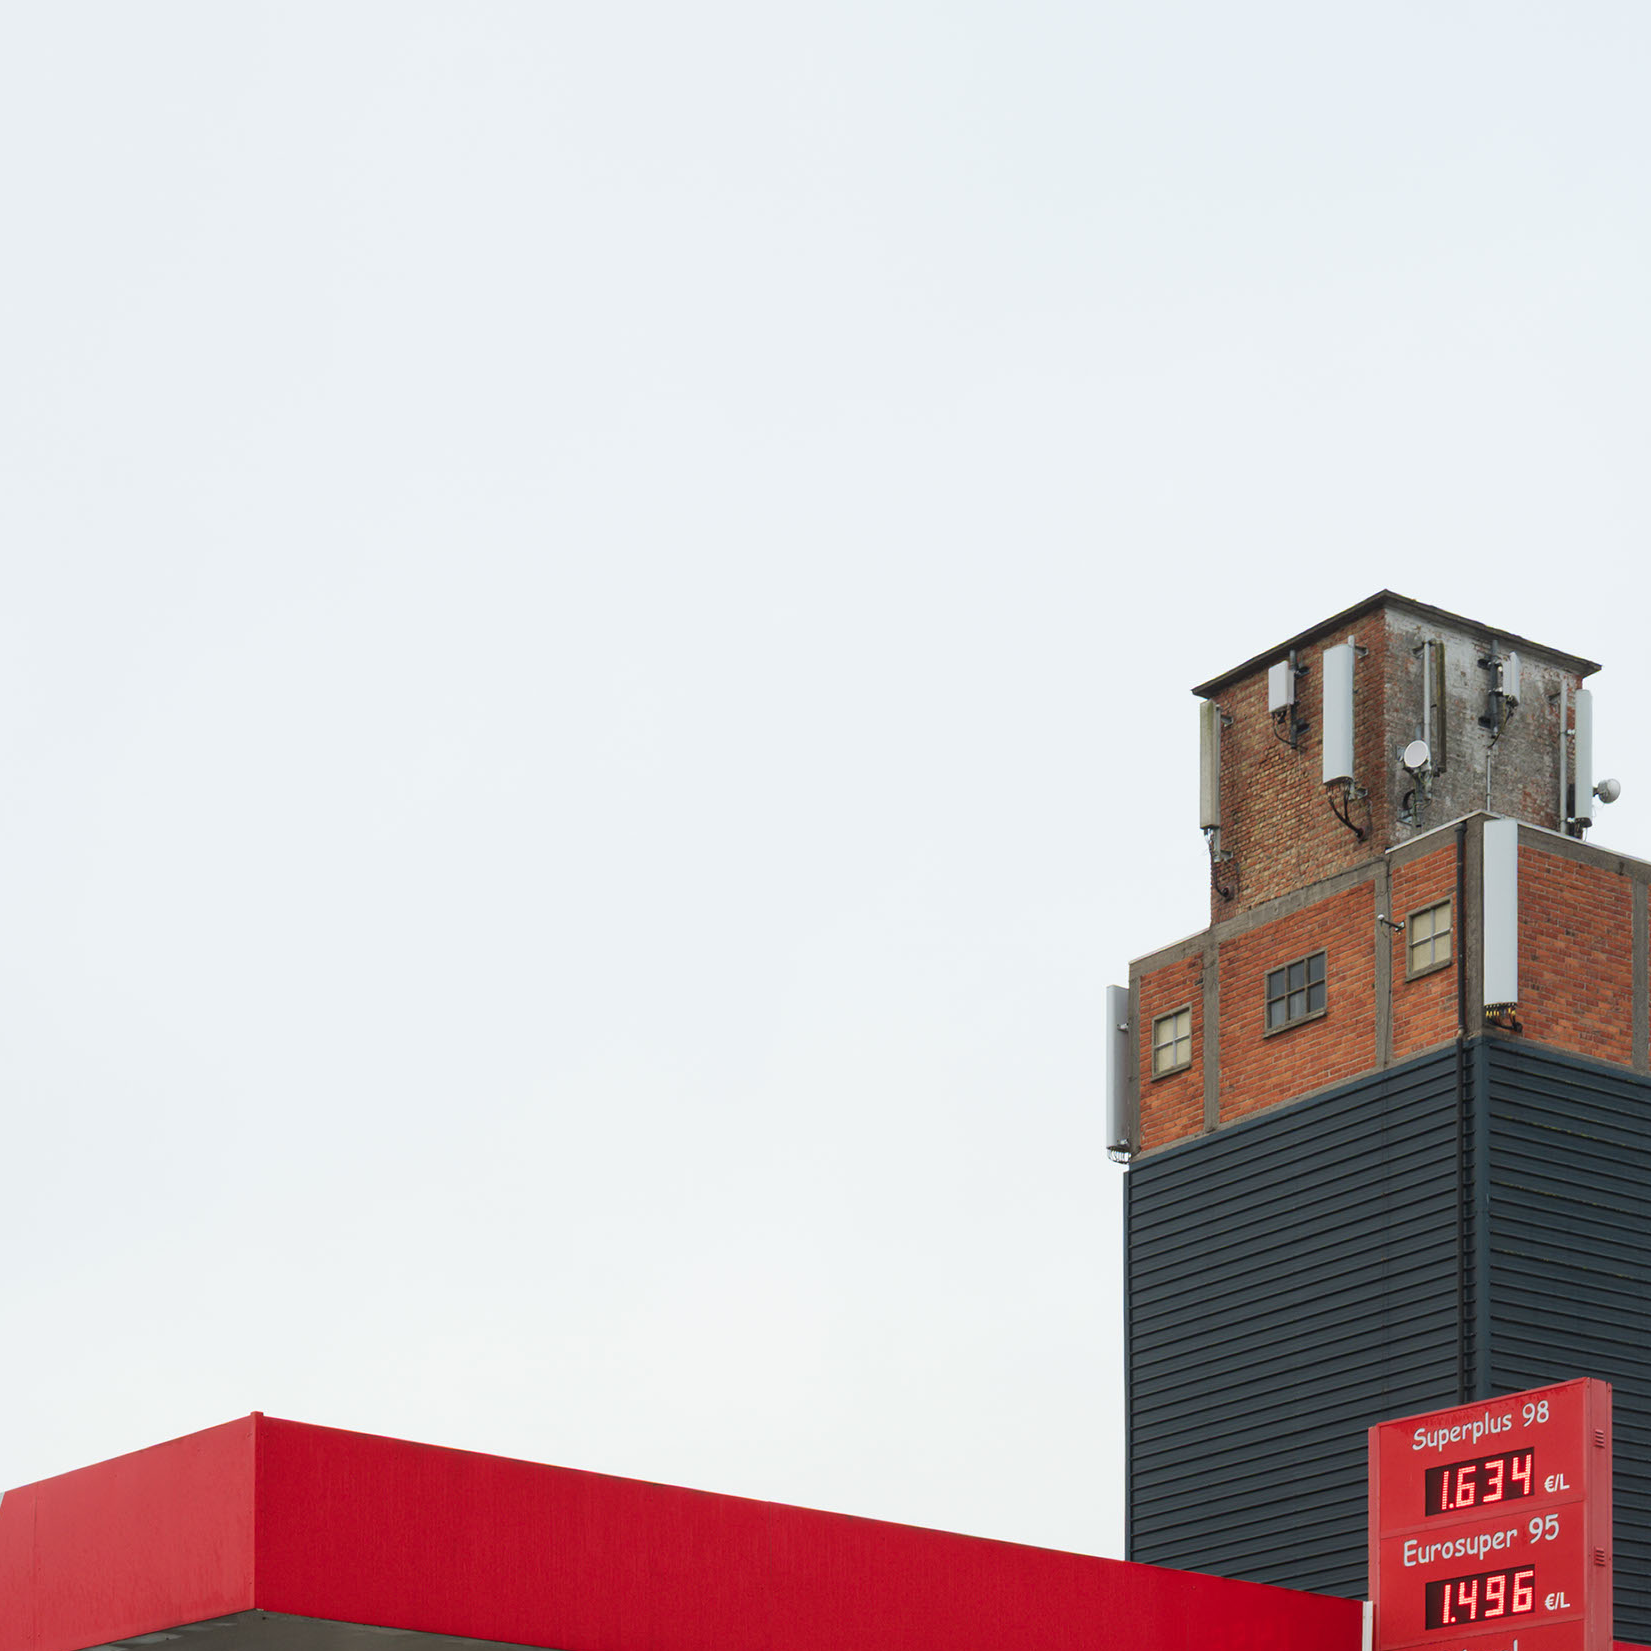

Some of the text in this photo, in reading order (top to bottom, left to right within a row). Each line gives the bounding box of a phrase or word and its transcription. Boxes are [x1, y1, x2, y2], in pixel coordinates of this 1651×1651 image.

[1411, 1400, 1550, 1452] Superplus 98
[1441, 1454, 1570, 1510] 1.634 €/L
[1403, 1514, 1560, 1567] Eurosuper 95
[1442, 1570, 1570, 1624] 1.496 €/L
